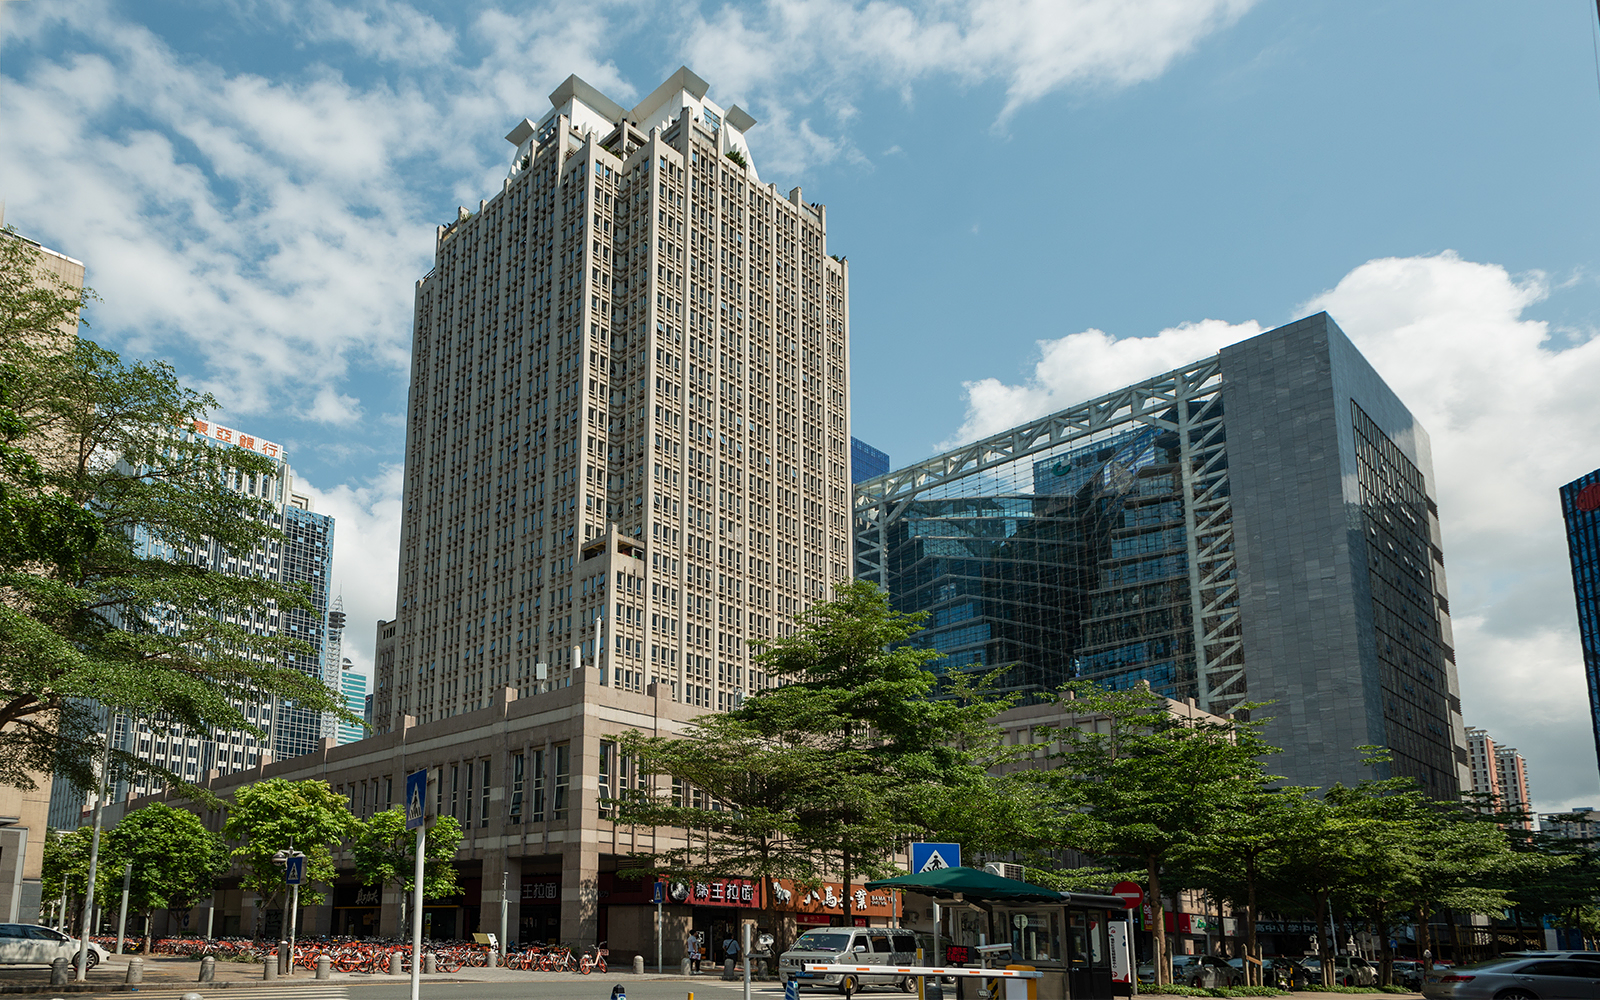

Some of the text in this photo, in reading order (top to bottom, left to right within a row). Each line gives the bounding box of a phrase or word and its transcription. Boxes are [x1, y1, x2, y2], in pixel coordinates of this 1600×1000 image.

[193, 420, 278, 457] 東亞銀行
[520, 882, 557, 899] 王拉面
